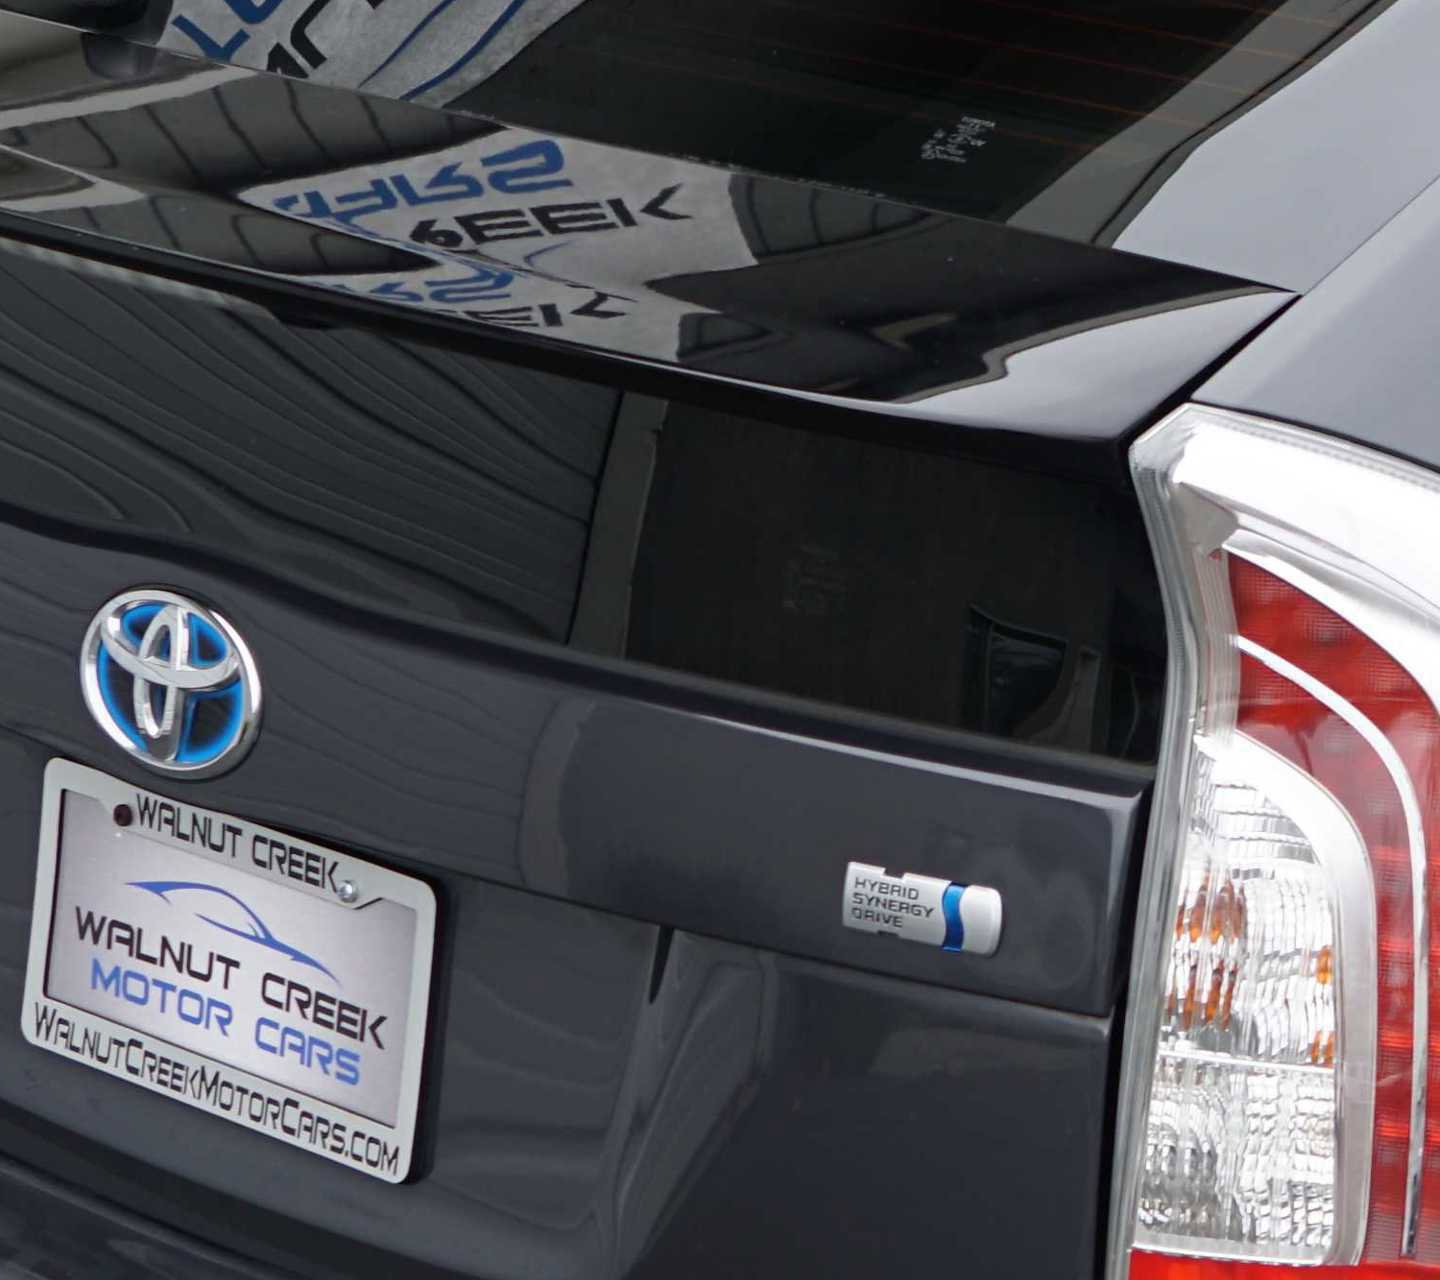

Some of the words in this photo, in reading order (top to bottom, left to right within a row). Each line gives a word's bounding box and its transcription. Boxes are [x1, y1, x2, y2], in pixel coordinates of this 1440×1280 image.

[136, 793, 243, 858] WALNUT
[252, 833, 343, 893] CREEK
[853, 892, 935, 919] SYNERGY
[853, 907, 904, 928] DRIVE
[854, 876, 920, 901] HYBRID
[74, 906, 241, 991] WALNUT
[260, 974, 388, 1051] CREEK
[89, 958, 235, 1038] MOTOR
[254, 1017, 362, 1087] CARS
